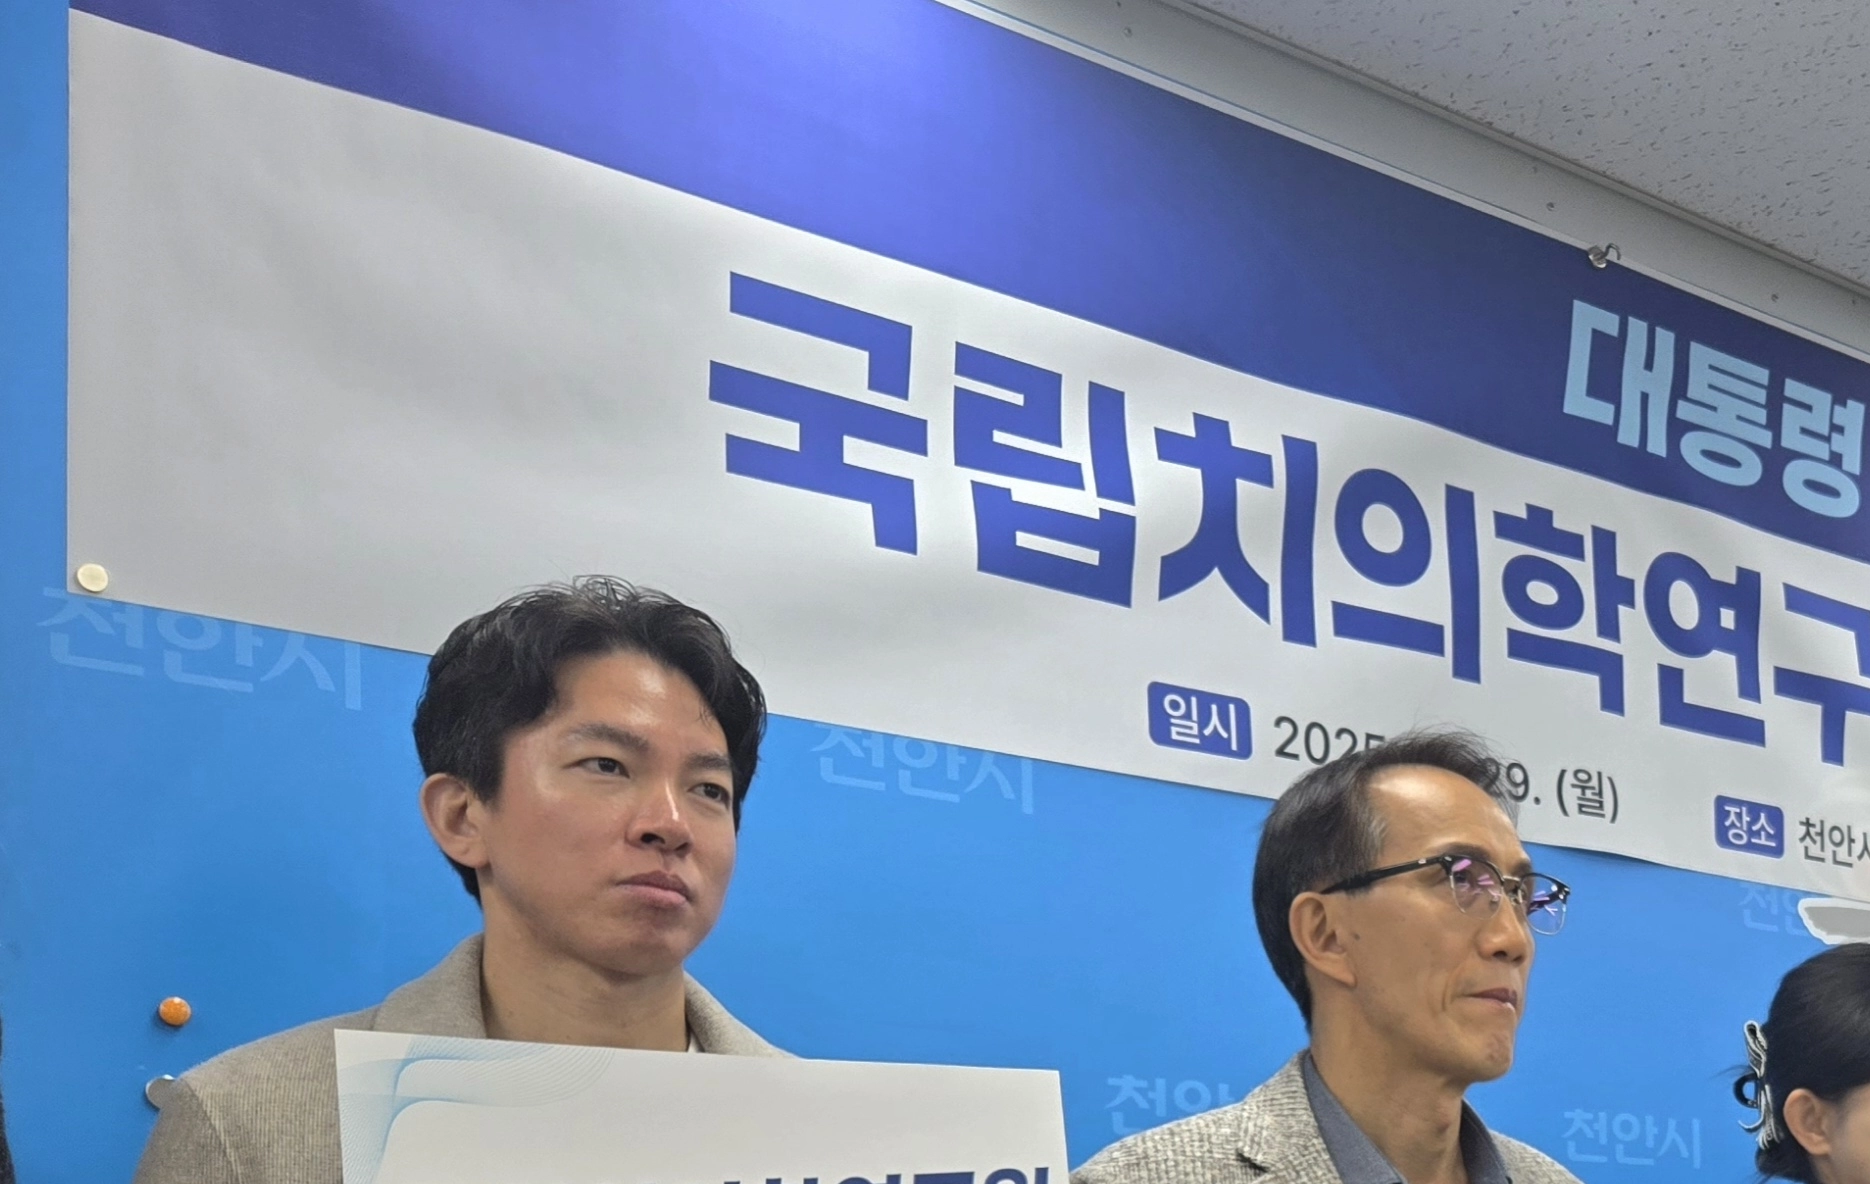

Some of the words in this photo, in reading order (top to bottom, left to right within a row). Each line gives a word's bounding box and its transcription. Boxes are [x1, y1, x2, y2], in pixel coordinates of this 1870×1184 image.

[1563, 298, 1867, 520] 대통령
[1162, 693, 1240, 751] 일시
[1556, 768, 1619, 824] (월)
[1724, 804, 1777, 848] 장소
[1563, 1109, 1702, 1169] 천안시
